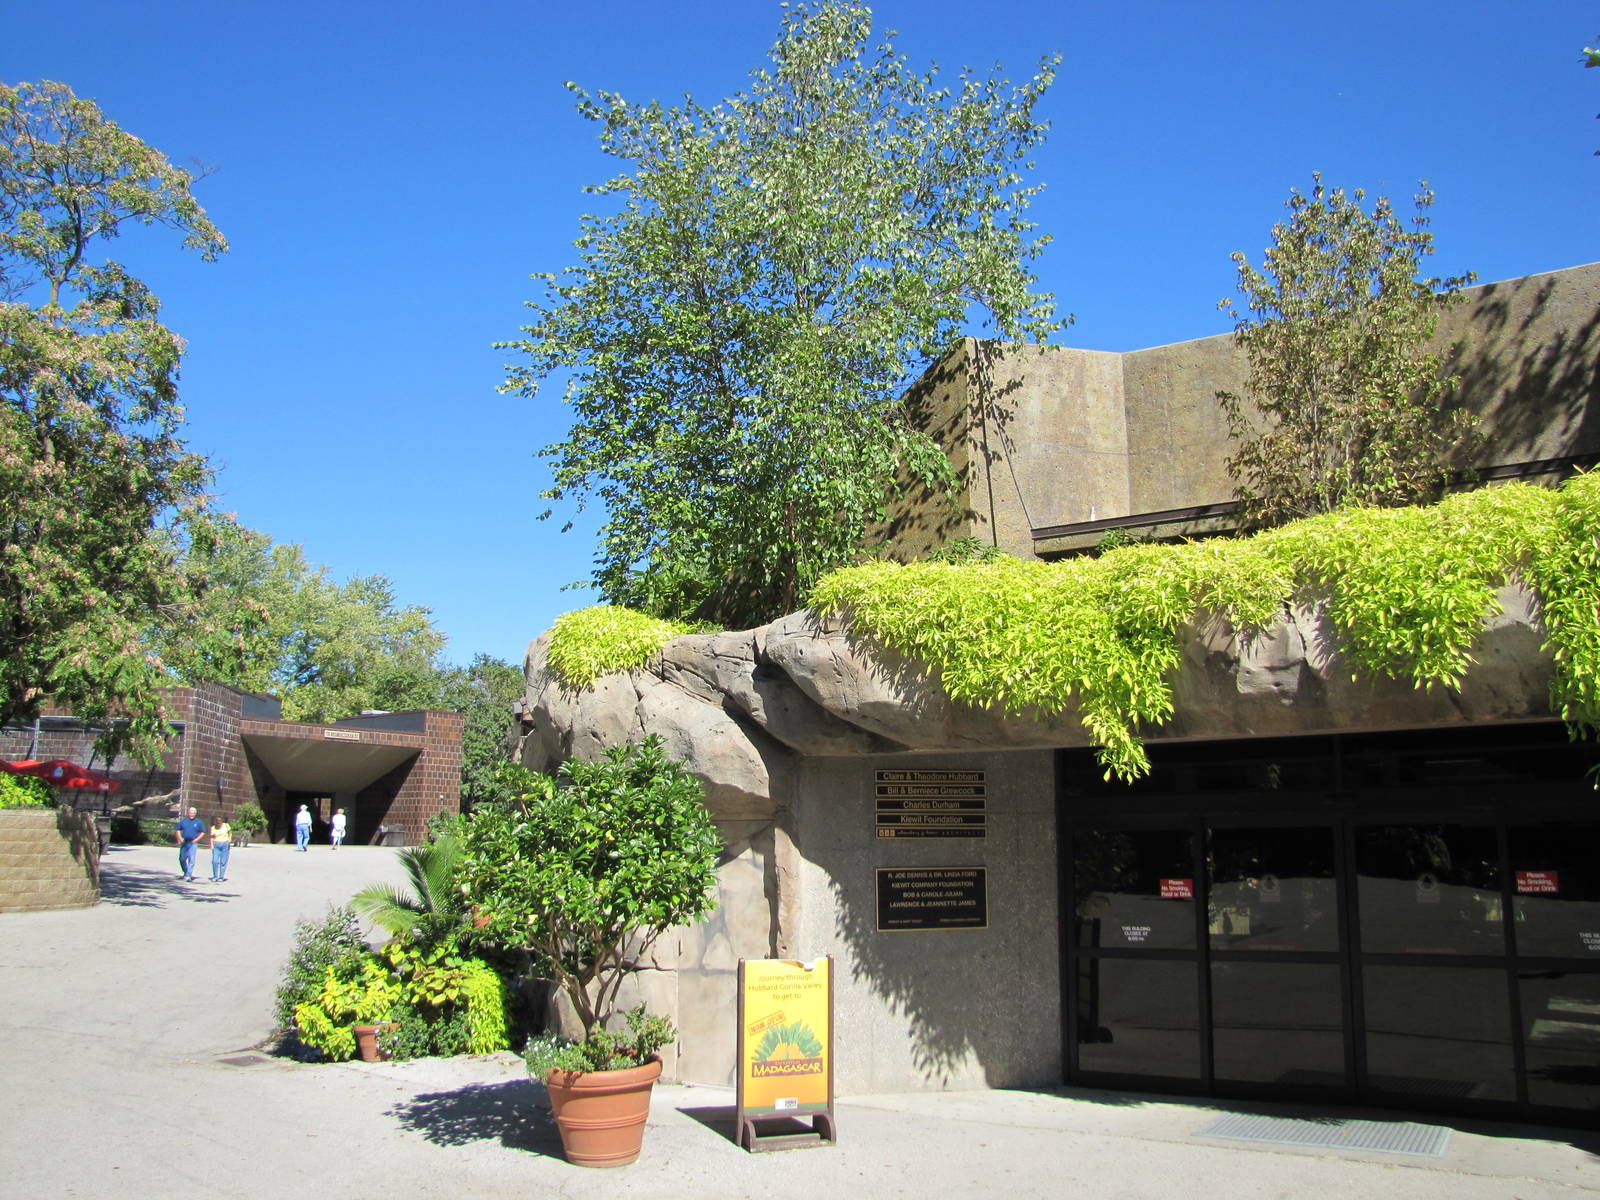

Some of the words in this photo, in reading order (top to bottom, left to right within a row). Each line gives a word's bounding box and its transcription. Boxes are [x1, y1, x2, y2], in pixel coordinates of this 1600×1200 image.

[883, 772, 905, 780] Claire
[914, 772, 947, 780] Theodore
[948, 772, 978, 781] Hubbard
[887, 786, 899, 794] Bill
[903, 801, 930, 809] Charles
[932, 801, 960, 809] Durham
[900, 815, 922, 823] Kiewit
[923, 815, 963, 823] Foundation
[785, 973, 812, 981] through
[781, 993, 792, 1001] get
[753, 1062, 821, 1076] MADAGASCAR
